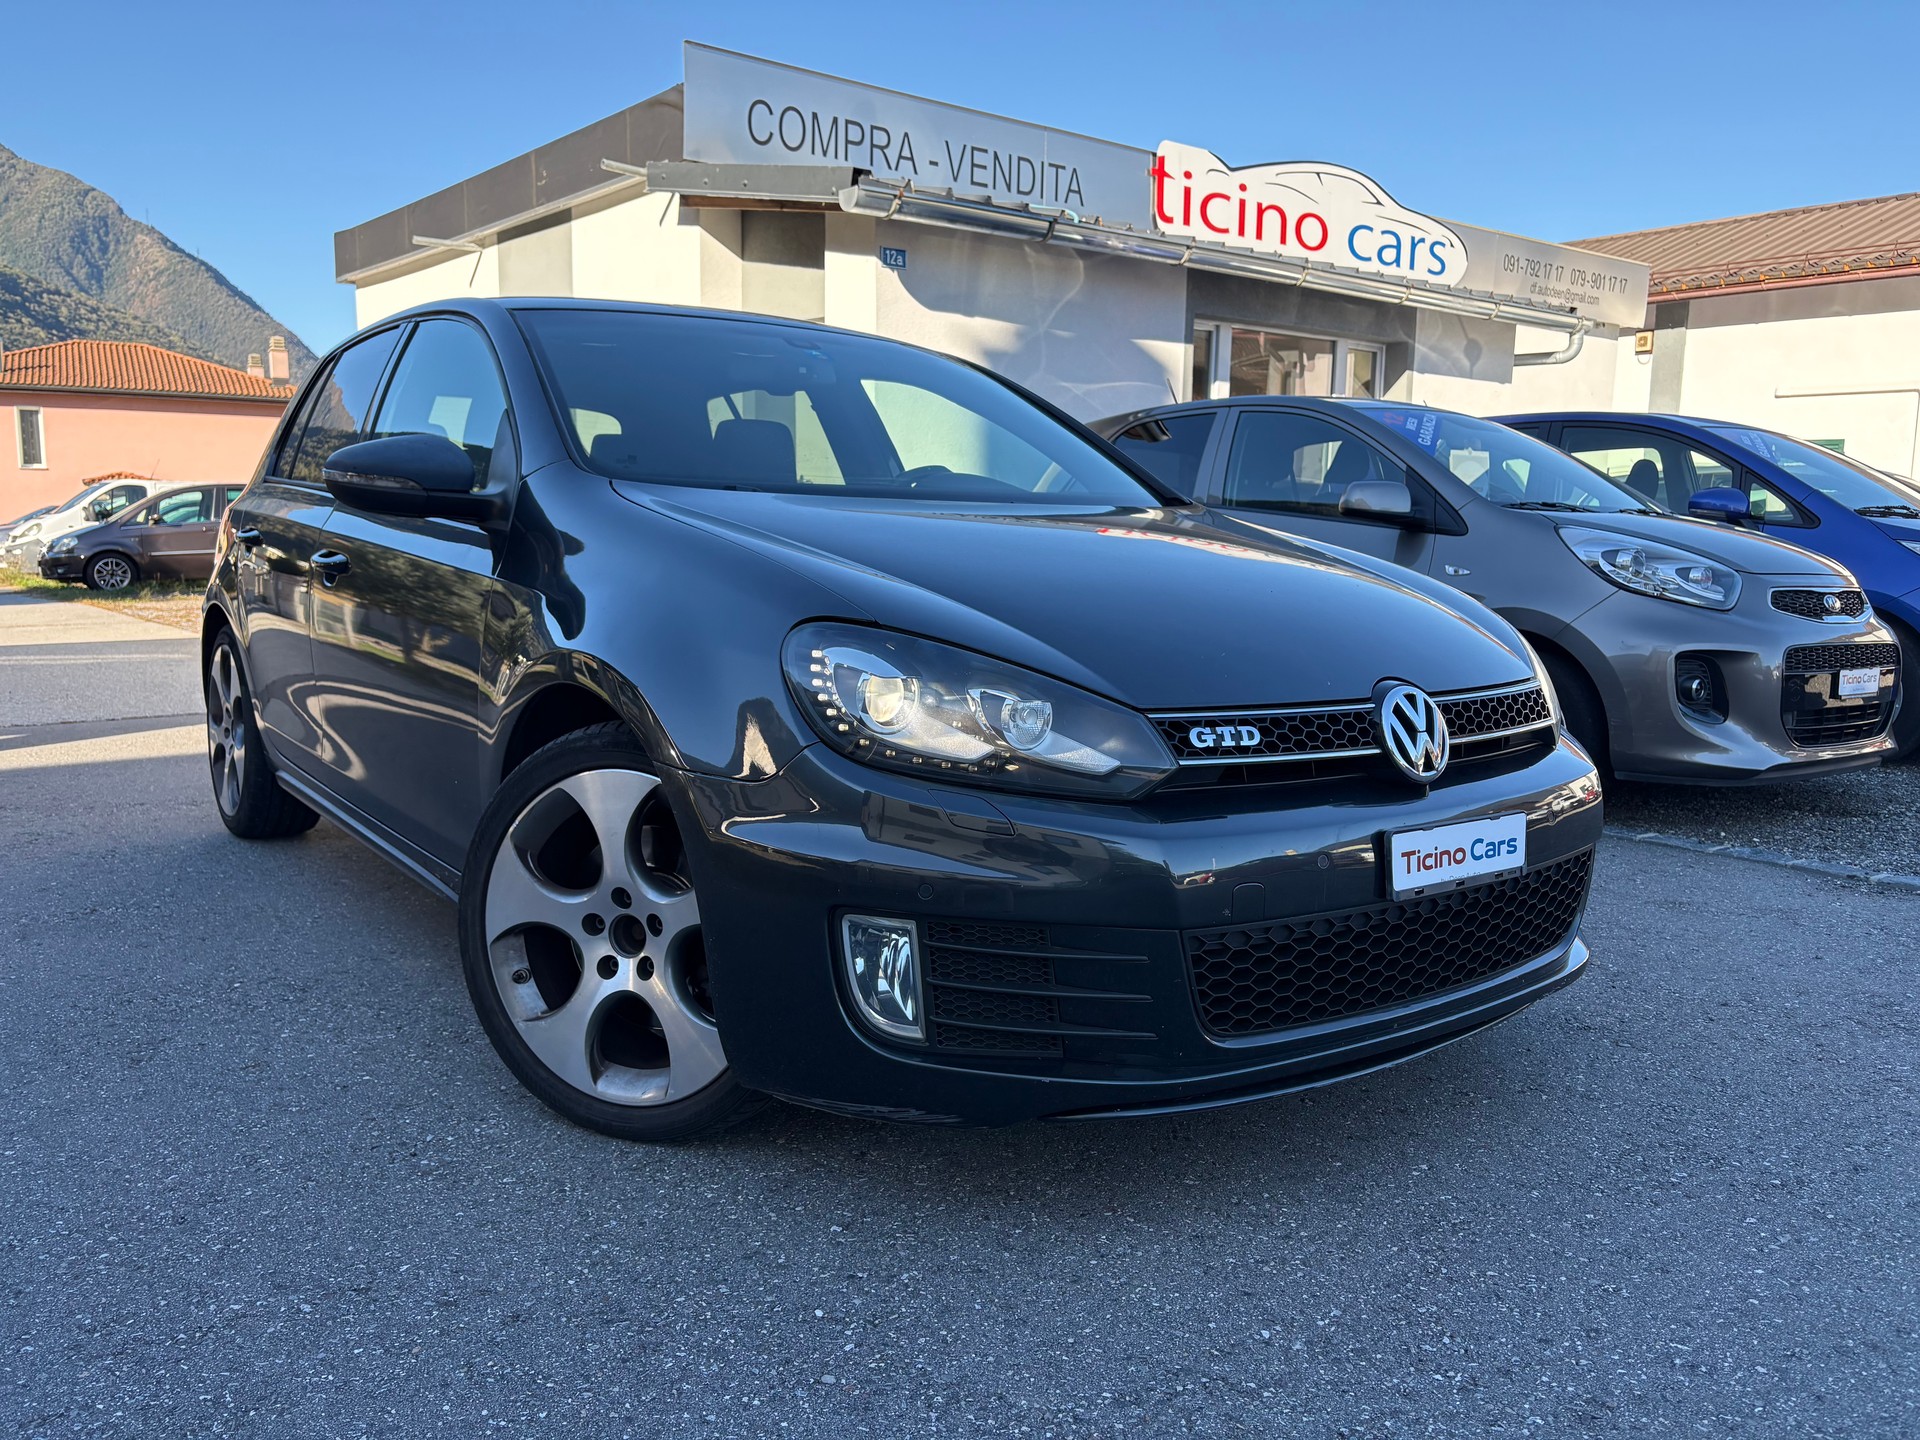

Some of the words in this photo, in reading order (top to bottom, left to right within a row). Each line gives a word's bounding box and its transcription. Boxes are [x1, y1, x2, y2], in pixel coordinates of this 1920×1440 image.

[747, 99, 918, 175] COMPRA
[944, 140, 1085, 207] VENDITA
[1151, 156, 1328, 251] ticino
[1347, 224, 1447, 276] cars
[885, 250, 903, 265] 12a
[1503, 253, 1541, 278] 091-792
[1543, 263, 1553, 280] 17
[1555, 266, 1564, 282] 17
[1619, 278, 1628, 294] 17
[1842, 674, 1862, 685] Ticino
[1862, 673, 1878, 683] Cars
[1189, 725, 1261, 748] GTD
[1401, 846, 1466, 874] Ticino
[1470, 838, 1518, 861] Cars
